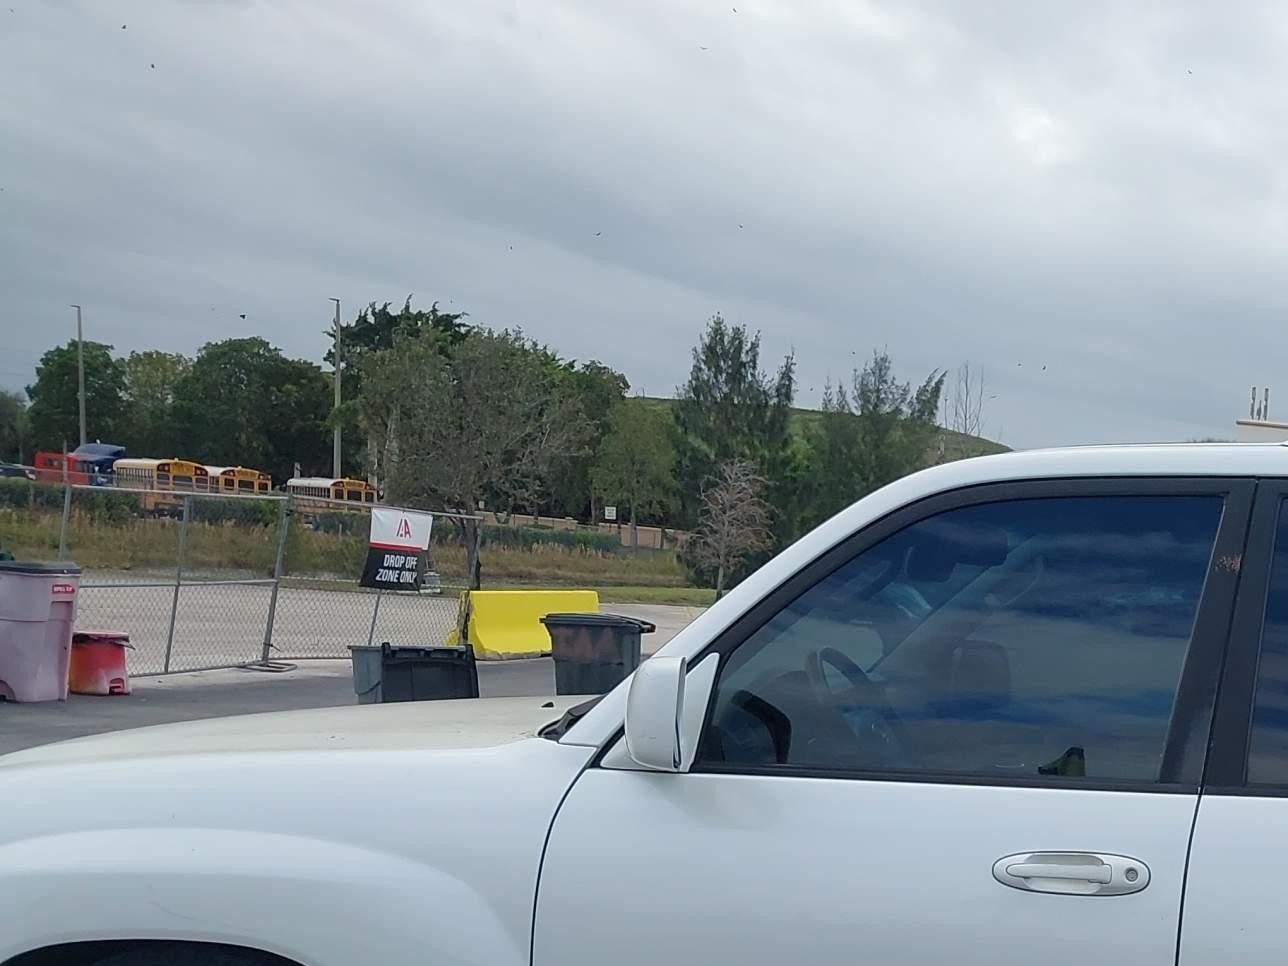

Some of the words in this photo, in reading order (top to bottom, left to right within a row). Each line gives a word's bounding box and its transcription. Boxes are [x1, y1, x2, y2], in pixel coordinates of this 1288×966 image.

[383, 554, 405, 568] DROP
[405, 556, 418, 569] OFF
[375, 568, 399, 582] ZONE
[400, 571, 418, 583] ONLY
